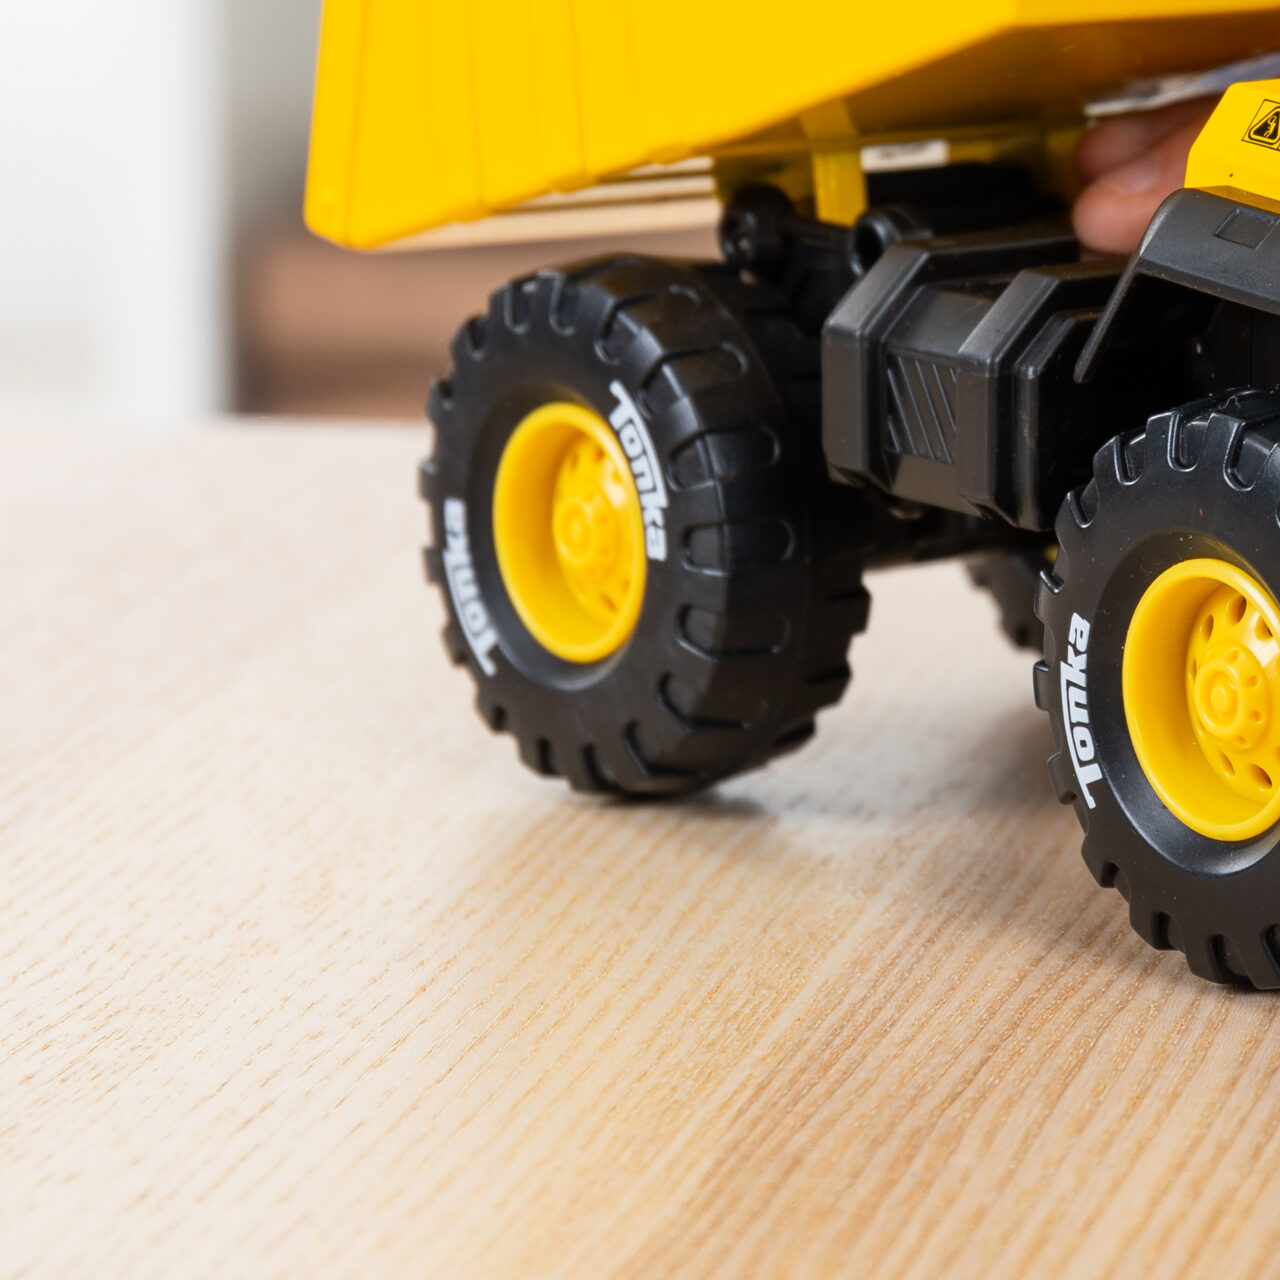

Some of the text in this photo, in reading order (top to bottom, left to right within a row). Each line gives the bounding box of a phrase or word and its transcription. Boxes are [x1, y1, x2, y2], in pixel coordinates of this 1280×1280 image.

[608, 379, 669, 562] Tonka
[443, 497, 501, 678] Tonka
[1060, 612, 1103, 809] Tonka
